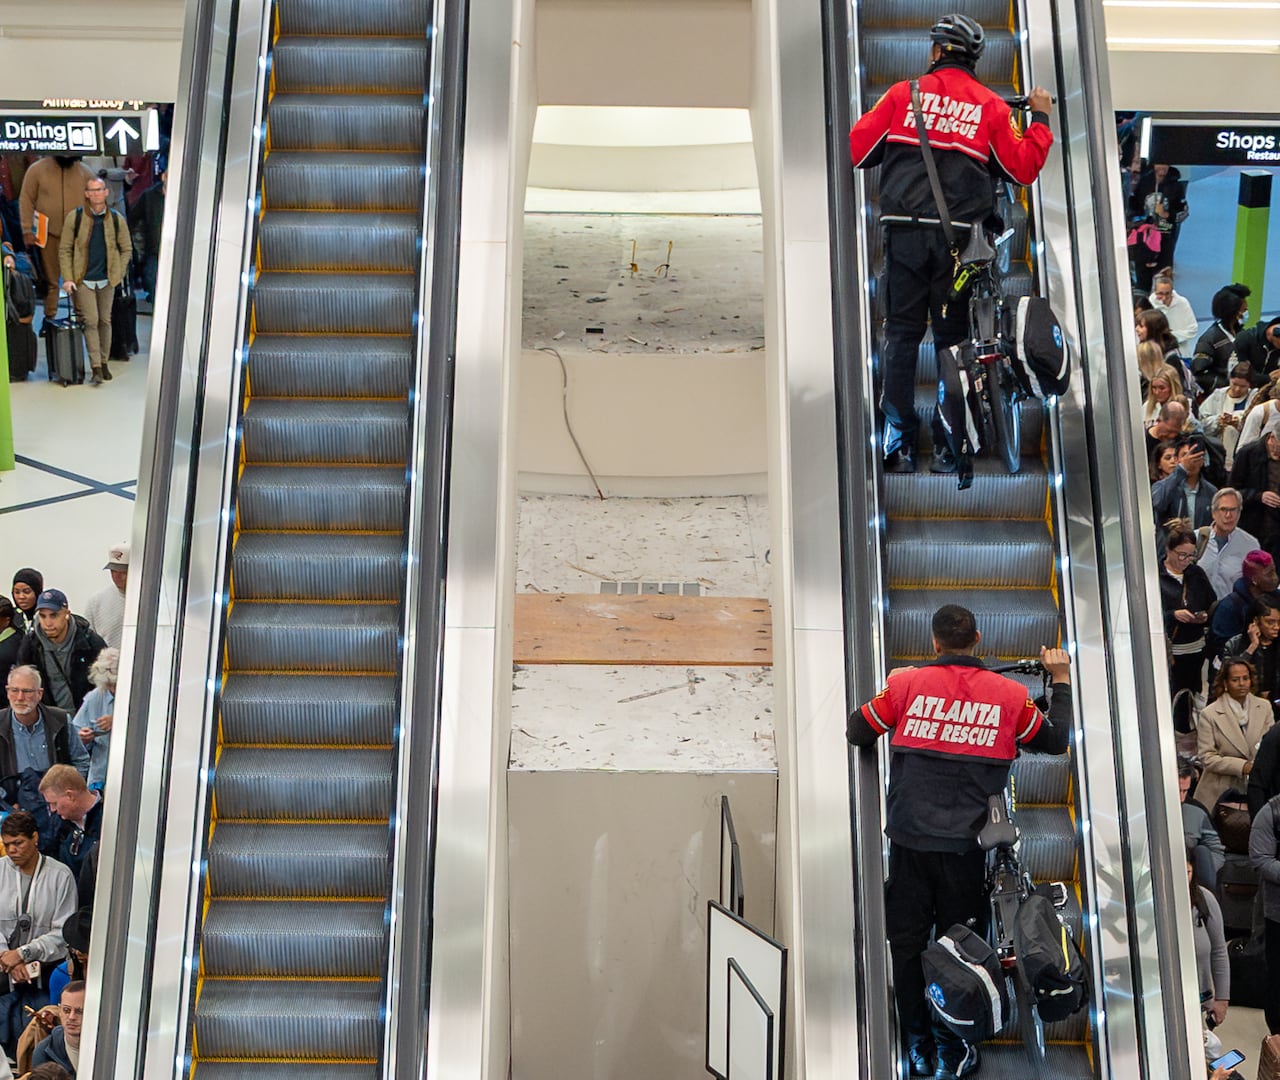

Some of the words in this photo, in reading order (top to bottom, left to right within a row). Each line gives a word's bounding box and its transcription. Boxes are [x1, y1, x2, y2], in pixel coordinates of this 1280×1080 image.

[5, 121, 66, 141] Dining
[20, 142, 28, 151] y
[28, 141, 68, 150] Tiendas
[1216, 132, 1276, 151] Shops
[906, 694, 1001, 727] ATLANTA
[903, 718, 940, 740] FIRE
[940, 723, 999, 747] RESCUE
